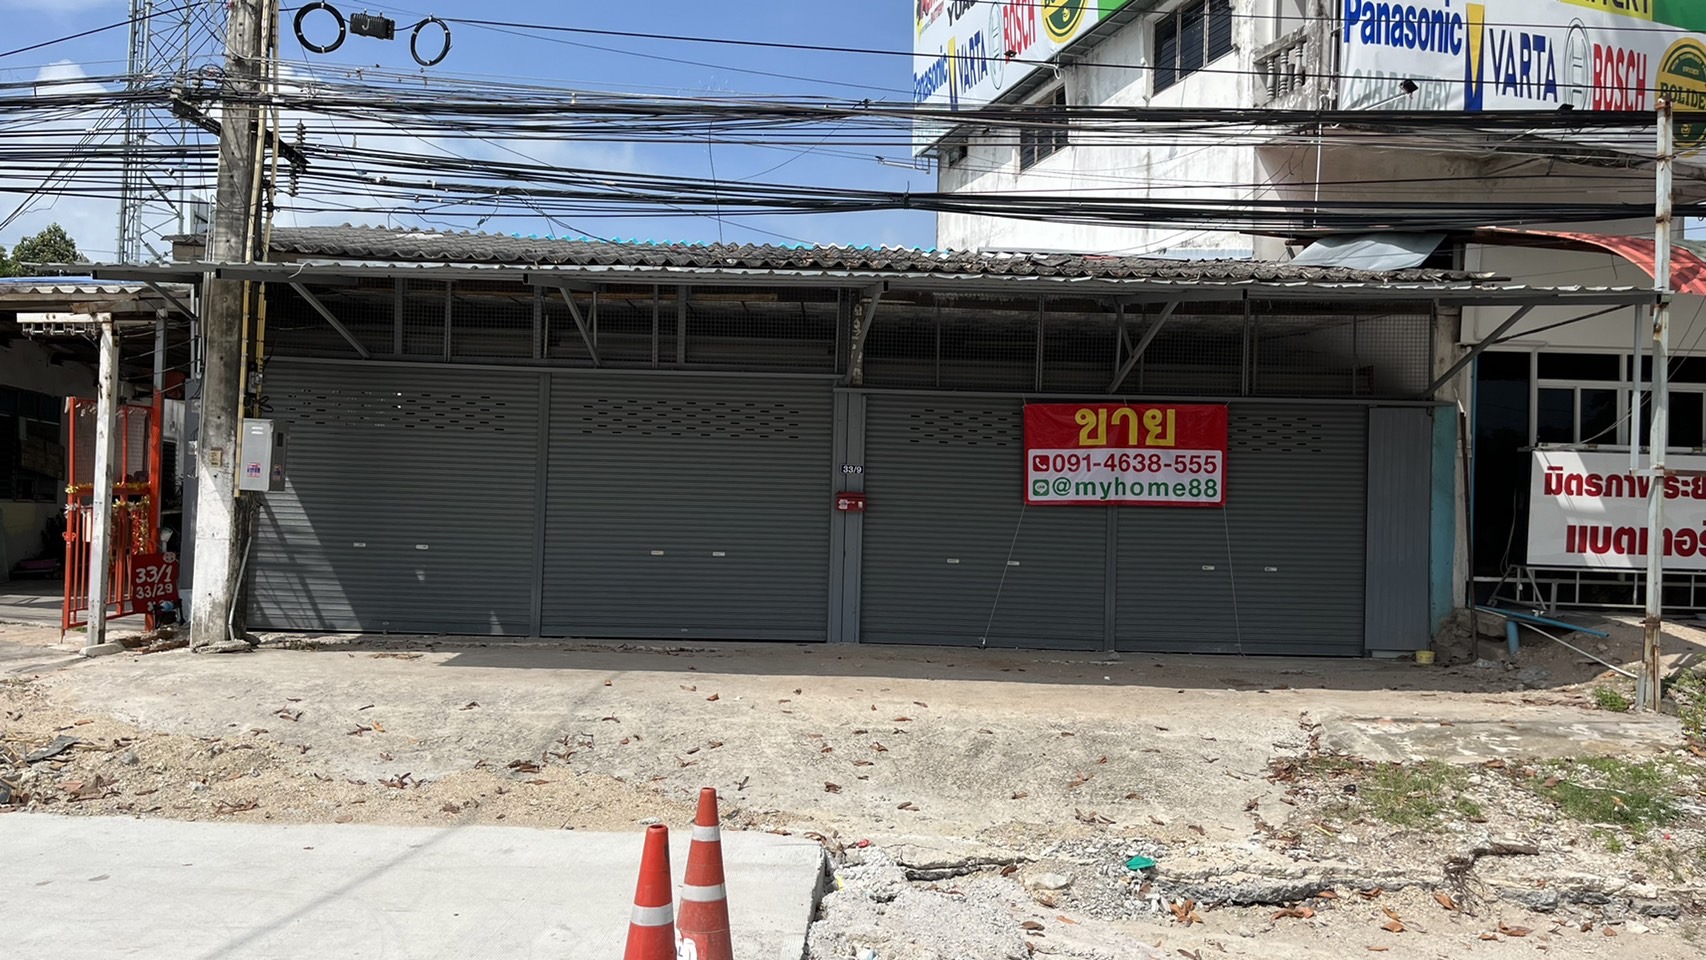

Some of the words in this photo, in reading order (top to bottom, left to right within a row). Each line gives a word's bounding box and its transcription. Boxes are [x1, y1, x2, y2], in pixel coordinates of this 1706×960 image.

[1003, 0, 1036, 64] BOSCH
[1344, 0, 1463, 56] Panasonic
[913, 44, 948, 104] Panasonic
[957, 30, 988, 95] VARTA
[1489, 28, 1558, 103] VARTA
[1593, 43, 1647, 111] BOSCH
[1074, 407, 1176, 447] ขาย
[843, 465, 862, 474] 33/9
[1052, 453, 1217, 474] 091-4638-555
[1052, 477, 1218, 500] @myhome88
[135, 563, 173, 584] 33/1
[135, 582, 173, 600] 33/29
